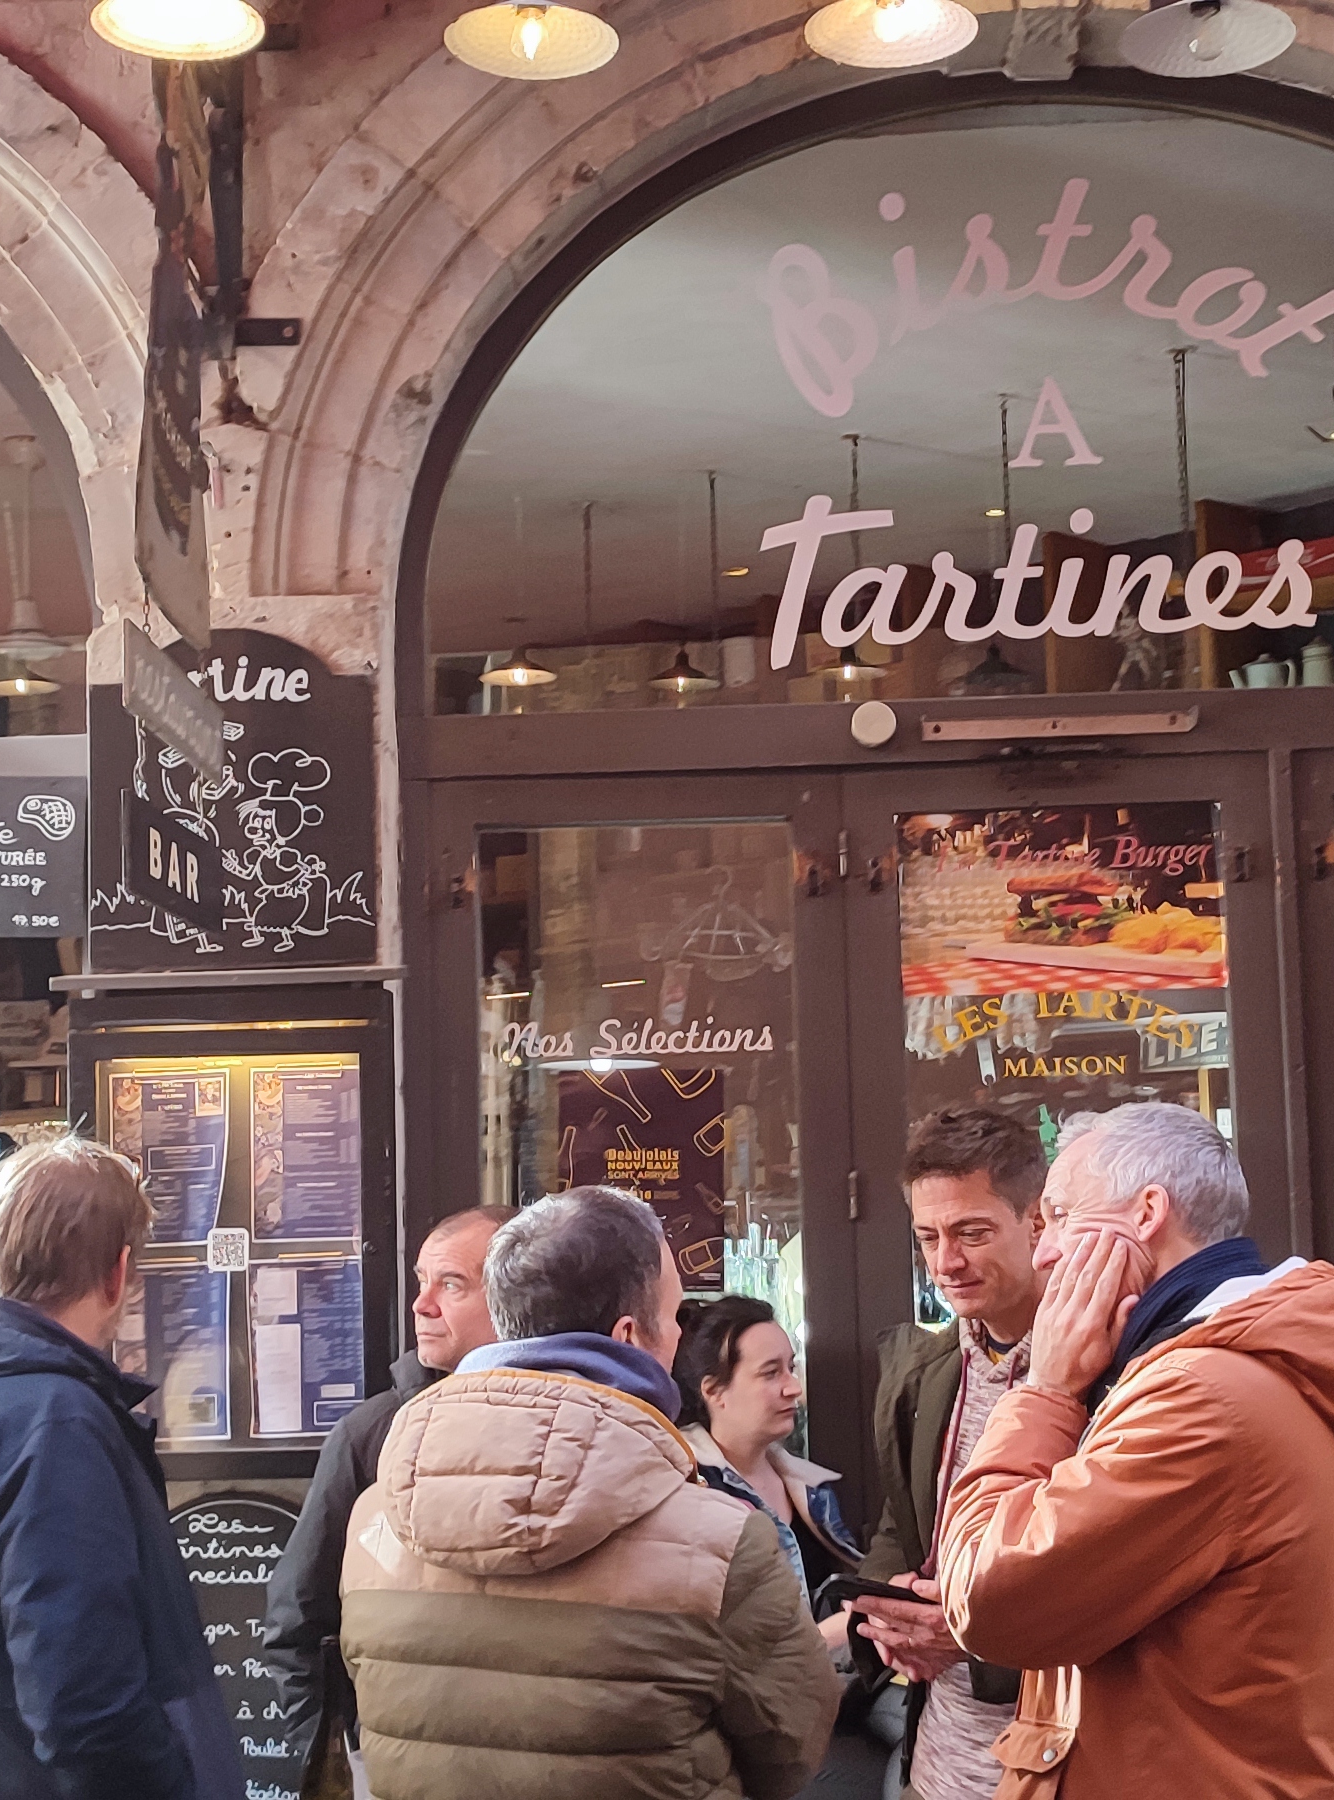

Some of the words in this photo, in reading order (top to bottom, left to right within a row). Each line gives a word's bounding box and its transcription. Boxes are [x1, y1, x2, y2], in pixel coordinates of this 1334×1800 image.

[1008, 376, 1104, 468] A
[760, 495, 1318, 671] Tartines
[189, 655, 312, 703] tine
[149, 826, 200, 904] BAR
[1109, 835, 1214, 877] Burger
[503, 1021, 575, 1058] Nos
[589, 1015, 775, 1058] Sélections
[931, 997, 1008, 1052] LES
[1036, 989, 1200, 1049] TARTES
[1003, 1055, 1128, 1078] MAISON
[203, 1622, 241, 1646] ger
[240, 1735, 291, 1757] Poulet
